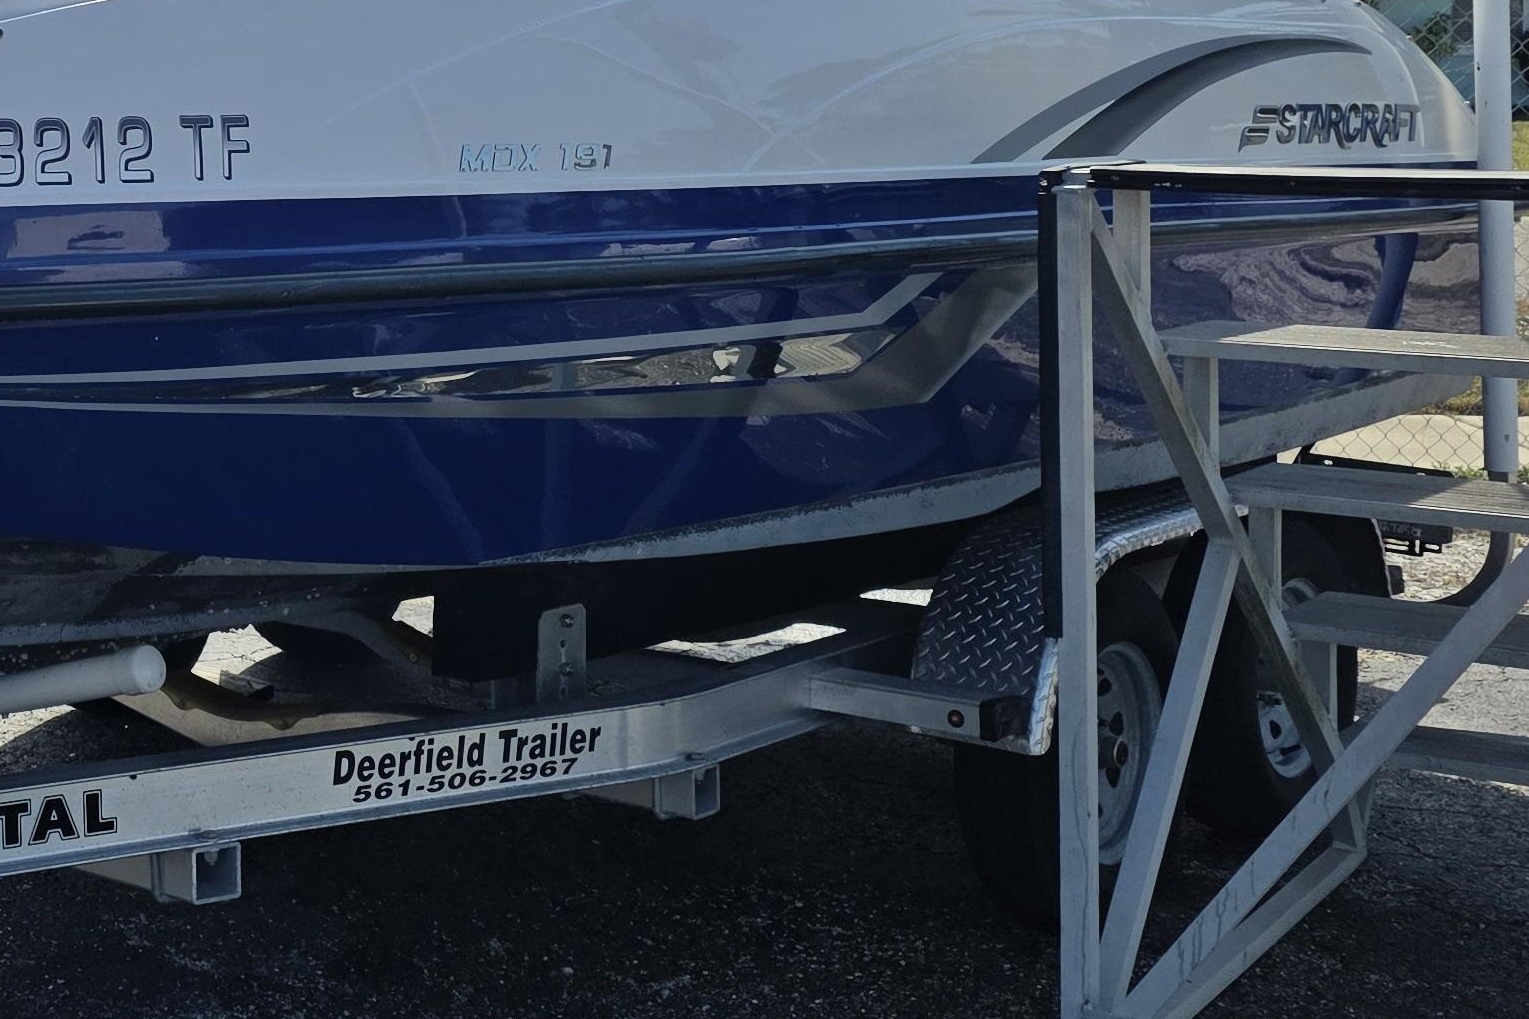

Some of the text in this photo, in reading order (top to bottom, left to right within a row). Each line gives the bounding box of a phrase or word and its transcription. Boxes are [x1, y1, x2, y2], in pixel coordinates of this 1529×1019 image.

[179, 114, 251, 182] TF
[1276, 103, 1420, 150] STARCRAFT
[459, 143, 613, 172] MDX 191
[332, 722, 602, 786] Deerfield Trailer
[351, 757, 579, 804] 561-506-2967
